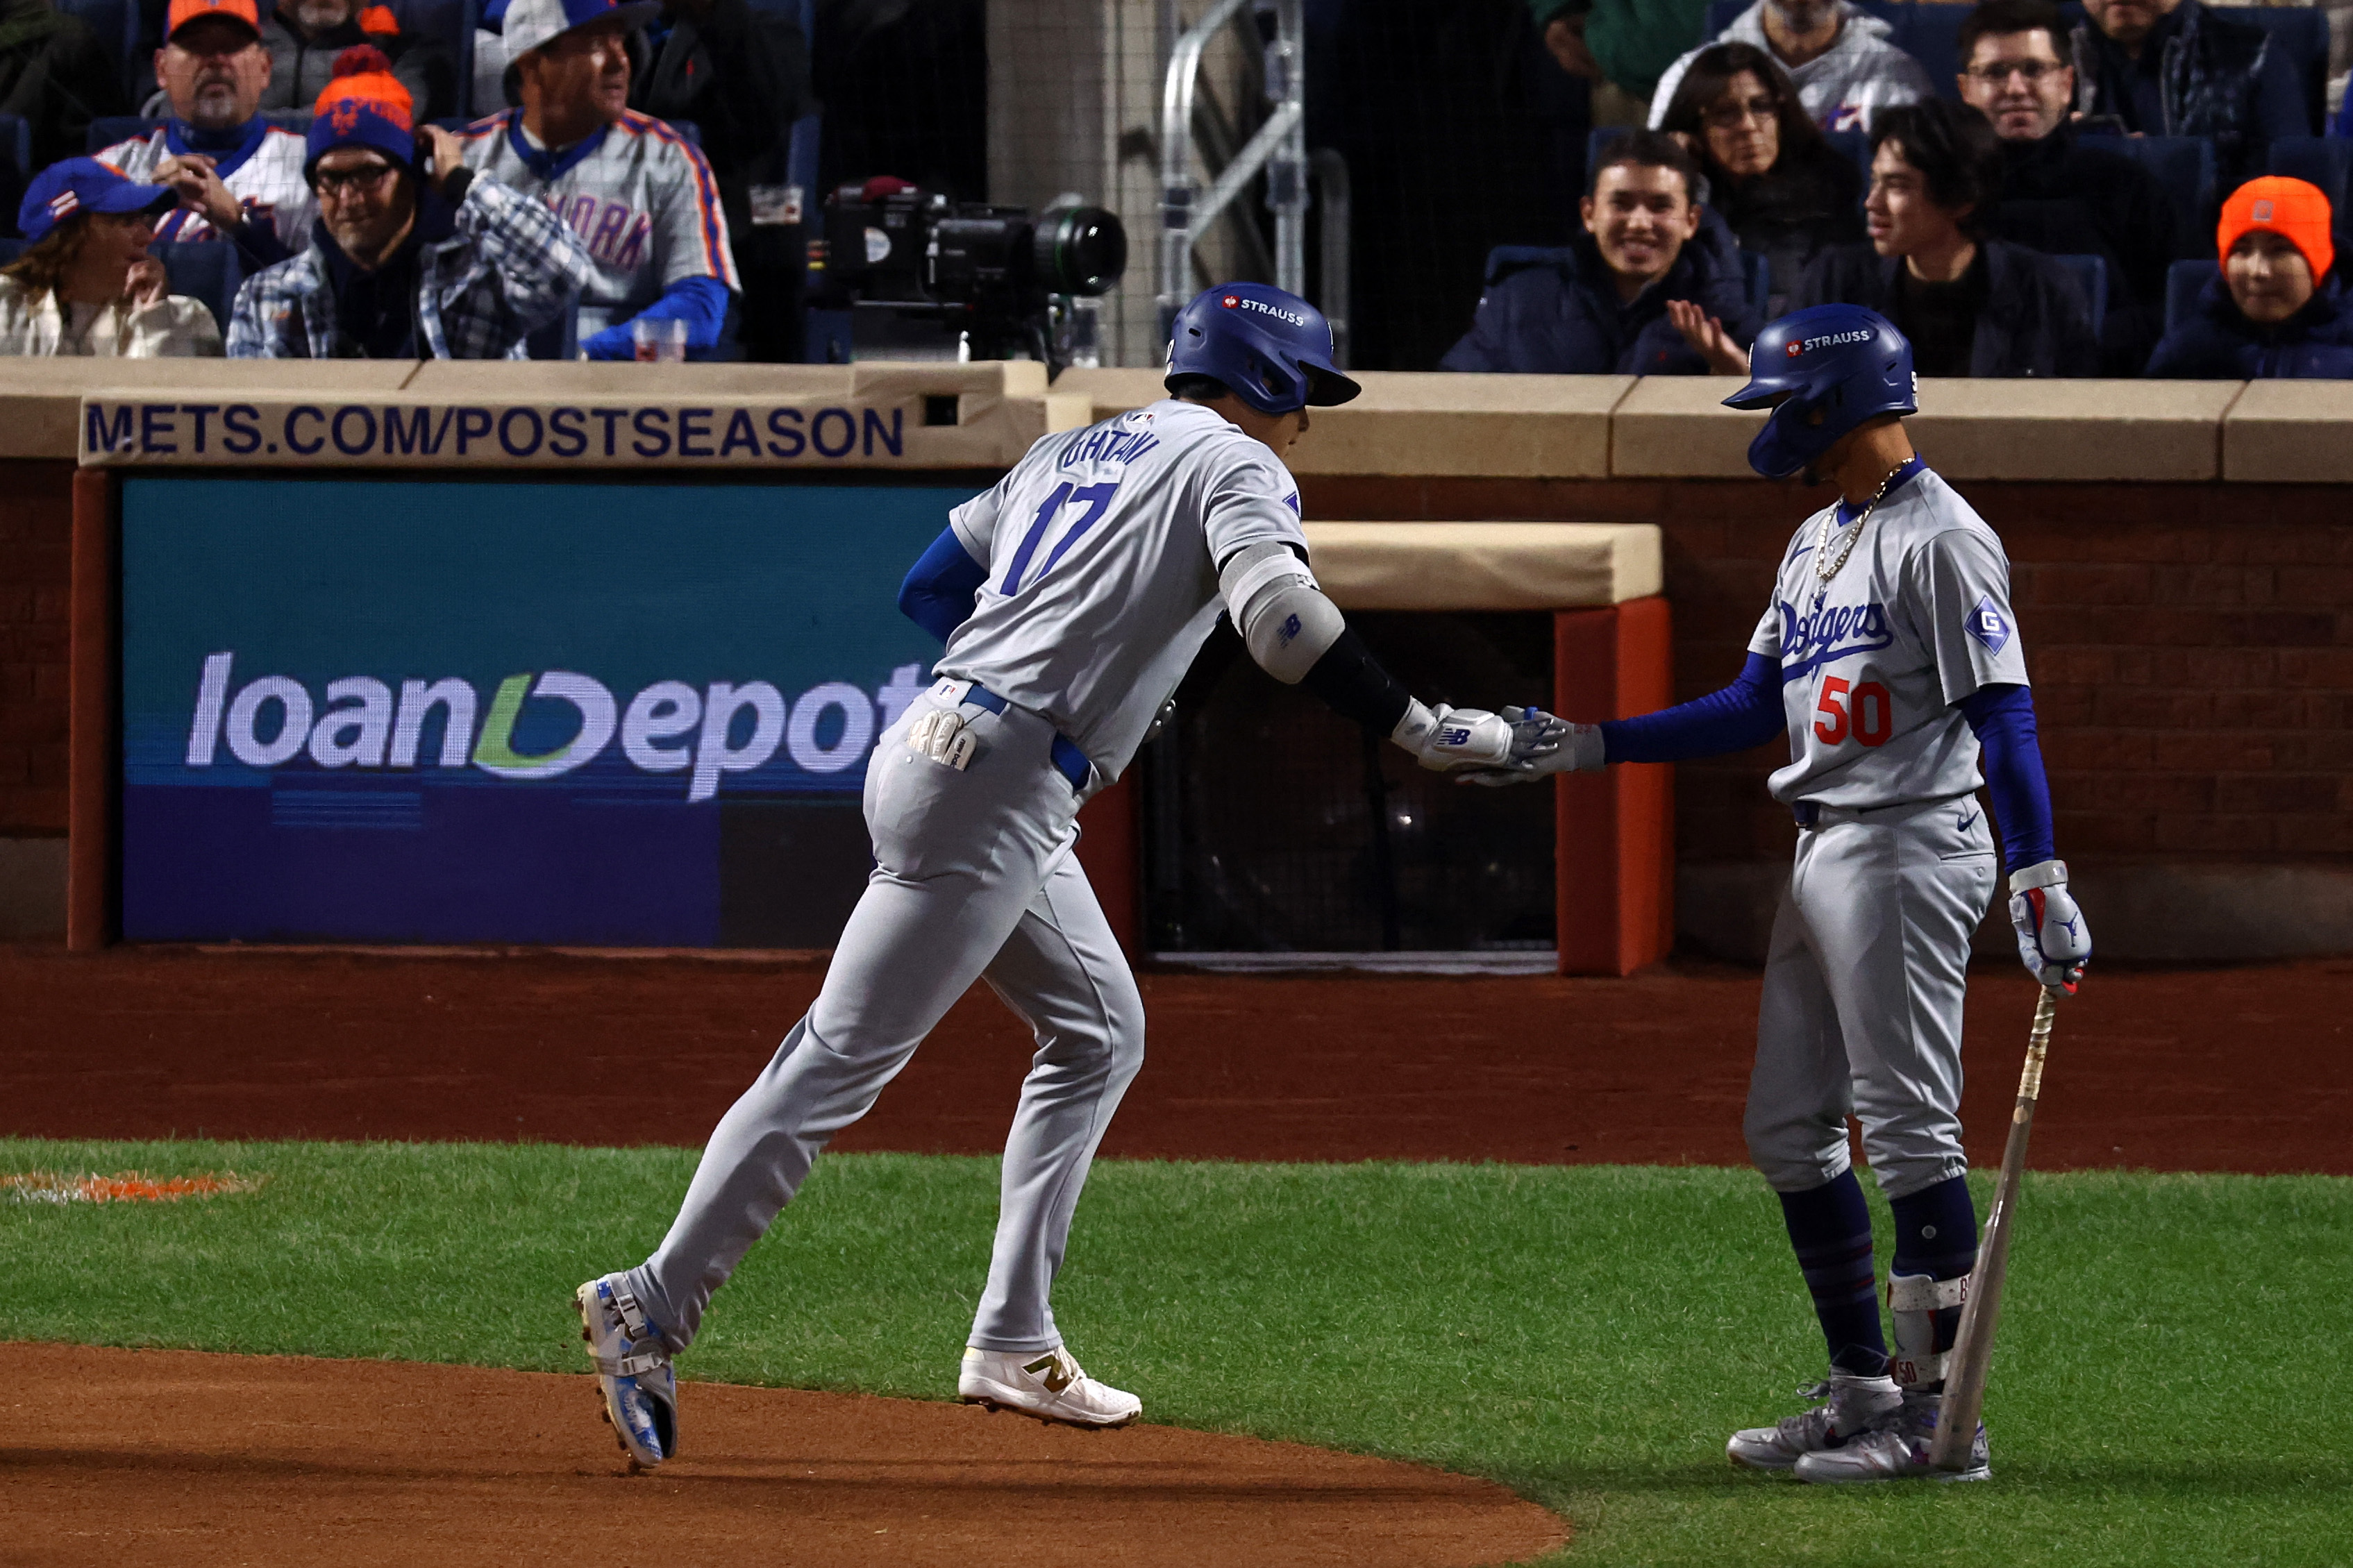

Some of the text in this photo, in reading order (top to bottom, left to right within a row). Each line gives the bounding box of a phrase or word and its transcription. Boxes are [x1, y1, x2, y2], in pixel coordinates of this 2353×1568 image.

[1241, 298, 1305, 328] STRAUSS
[1804, 330, 1870, 351] STRAUSS
[86, 403, 903, 457] METS.COM/POSTSEASON
[1063, 430, 1160, 468] OHTANI
[999, 482, 1120, 597] 17
[1781, 591, 1894, 683] Dodgers
[1981, 611, 2000, 631] G
[185, 650, 932, 803] loanDepot
[1814, 675, 1893, 747] 50
